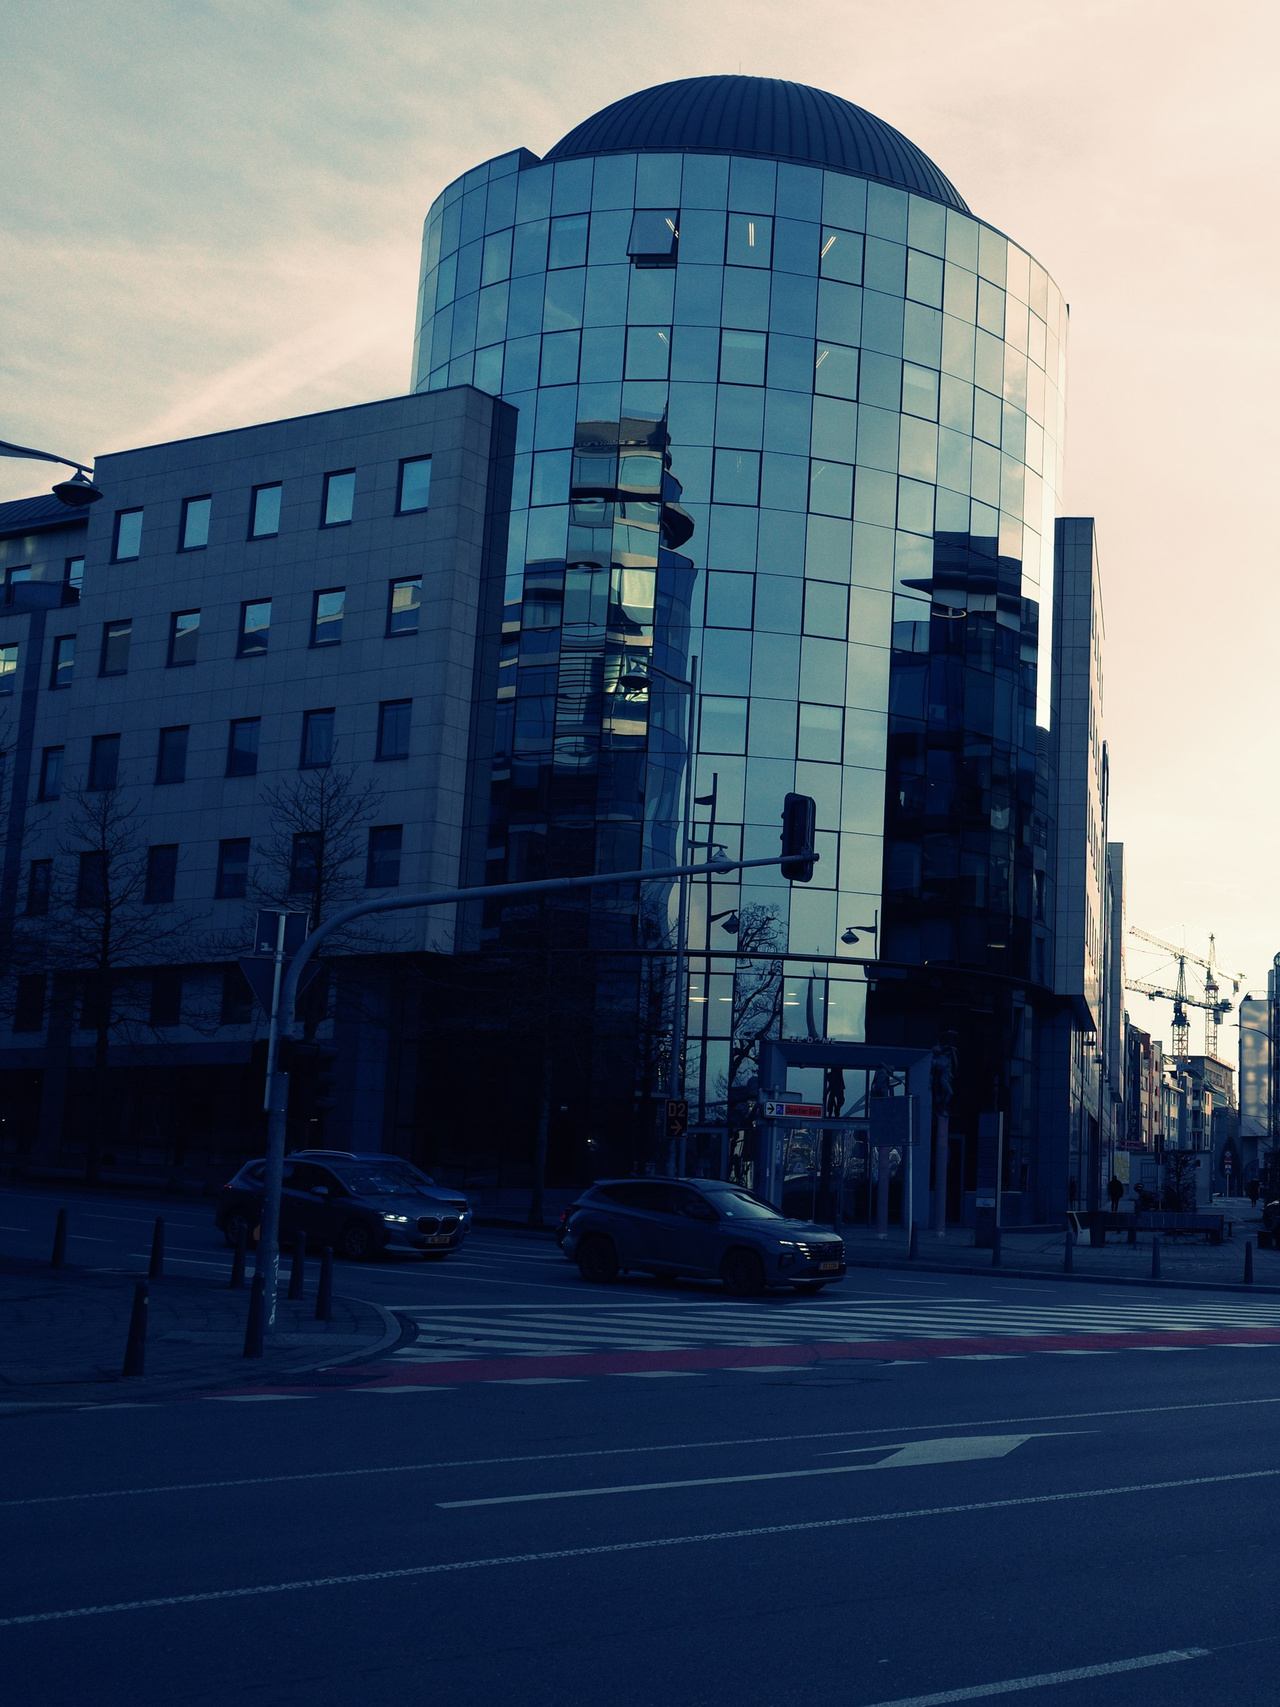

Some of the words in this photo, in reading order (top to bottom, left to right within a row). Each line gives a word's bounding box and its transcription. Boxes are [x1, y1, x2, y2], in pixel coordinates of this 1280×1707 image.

[668, 1103, 685, 1117] D2
[786, 1106, 807, 1114] Quartier
[809, 1107, 821, 1115] Gare
